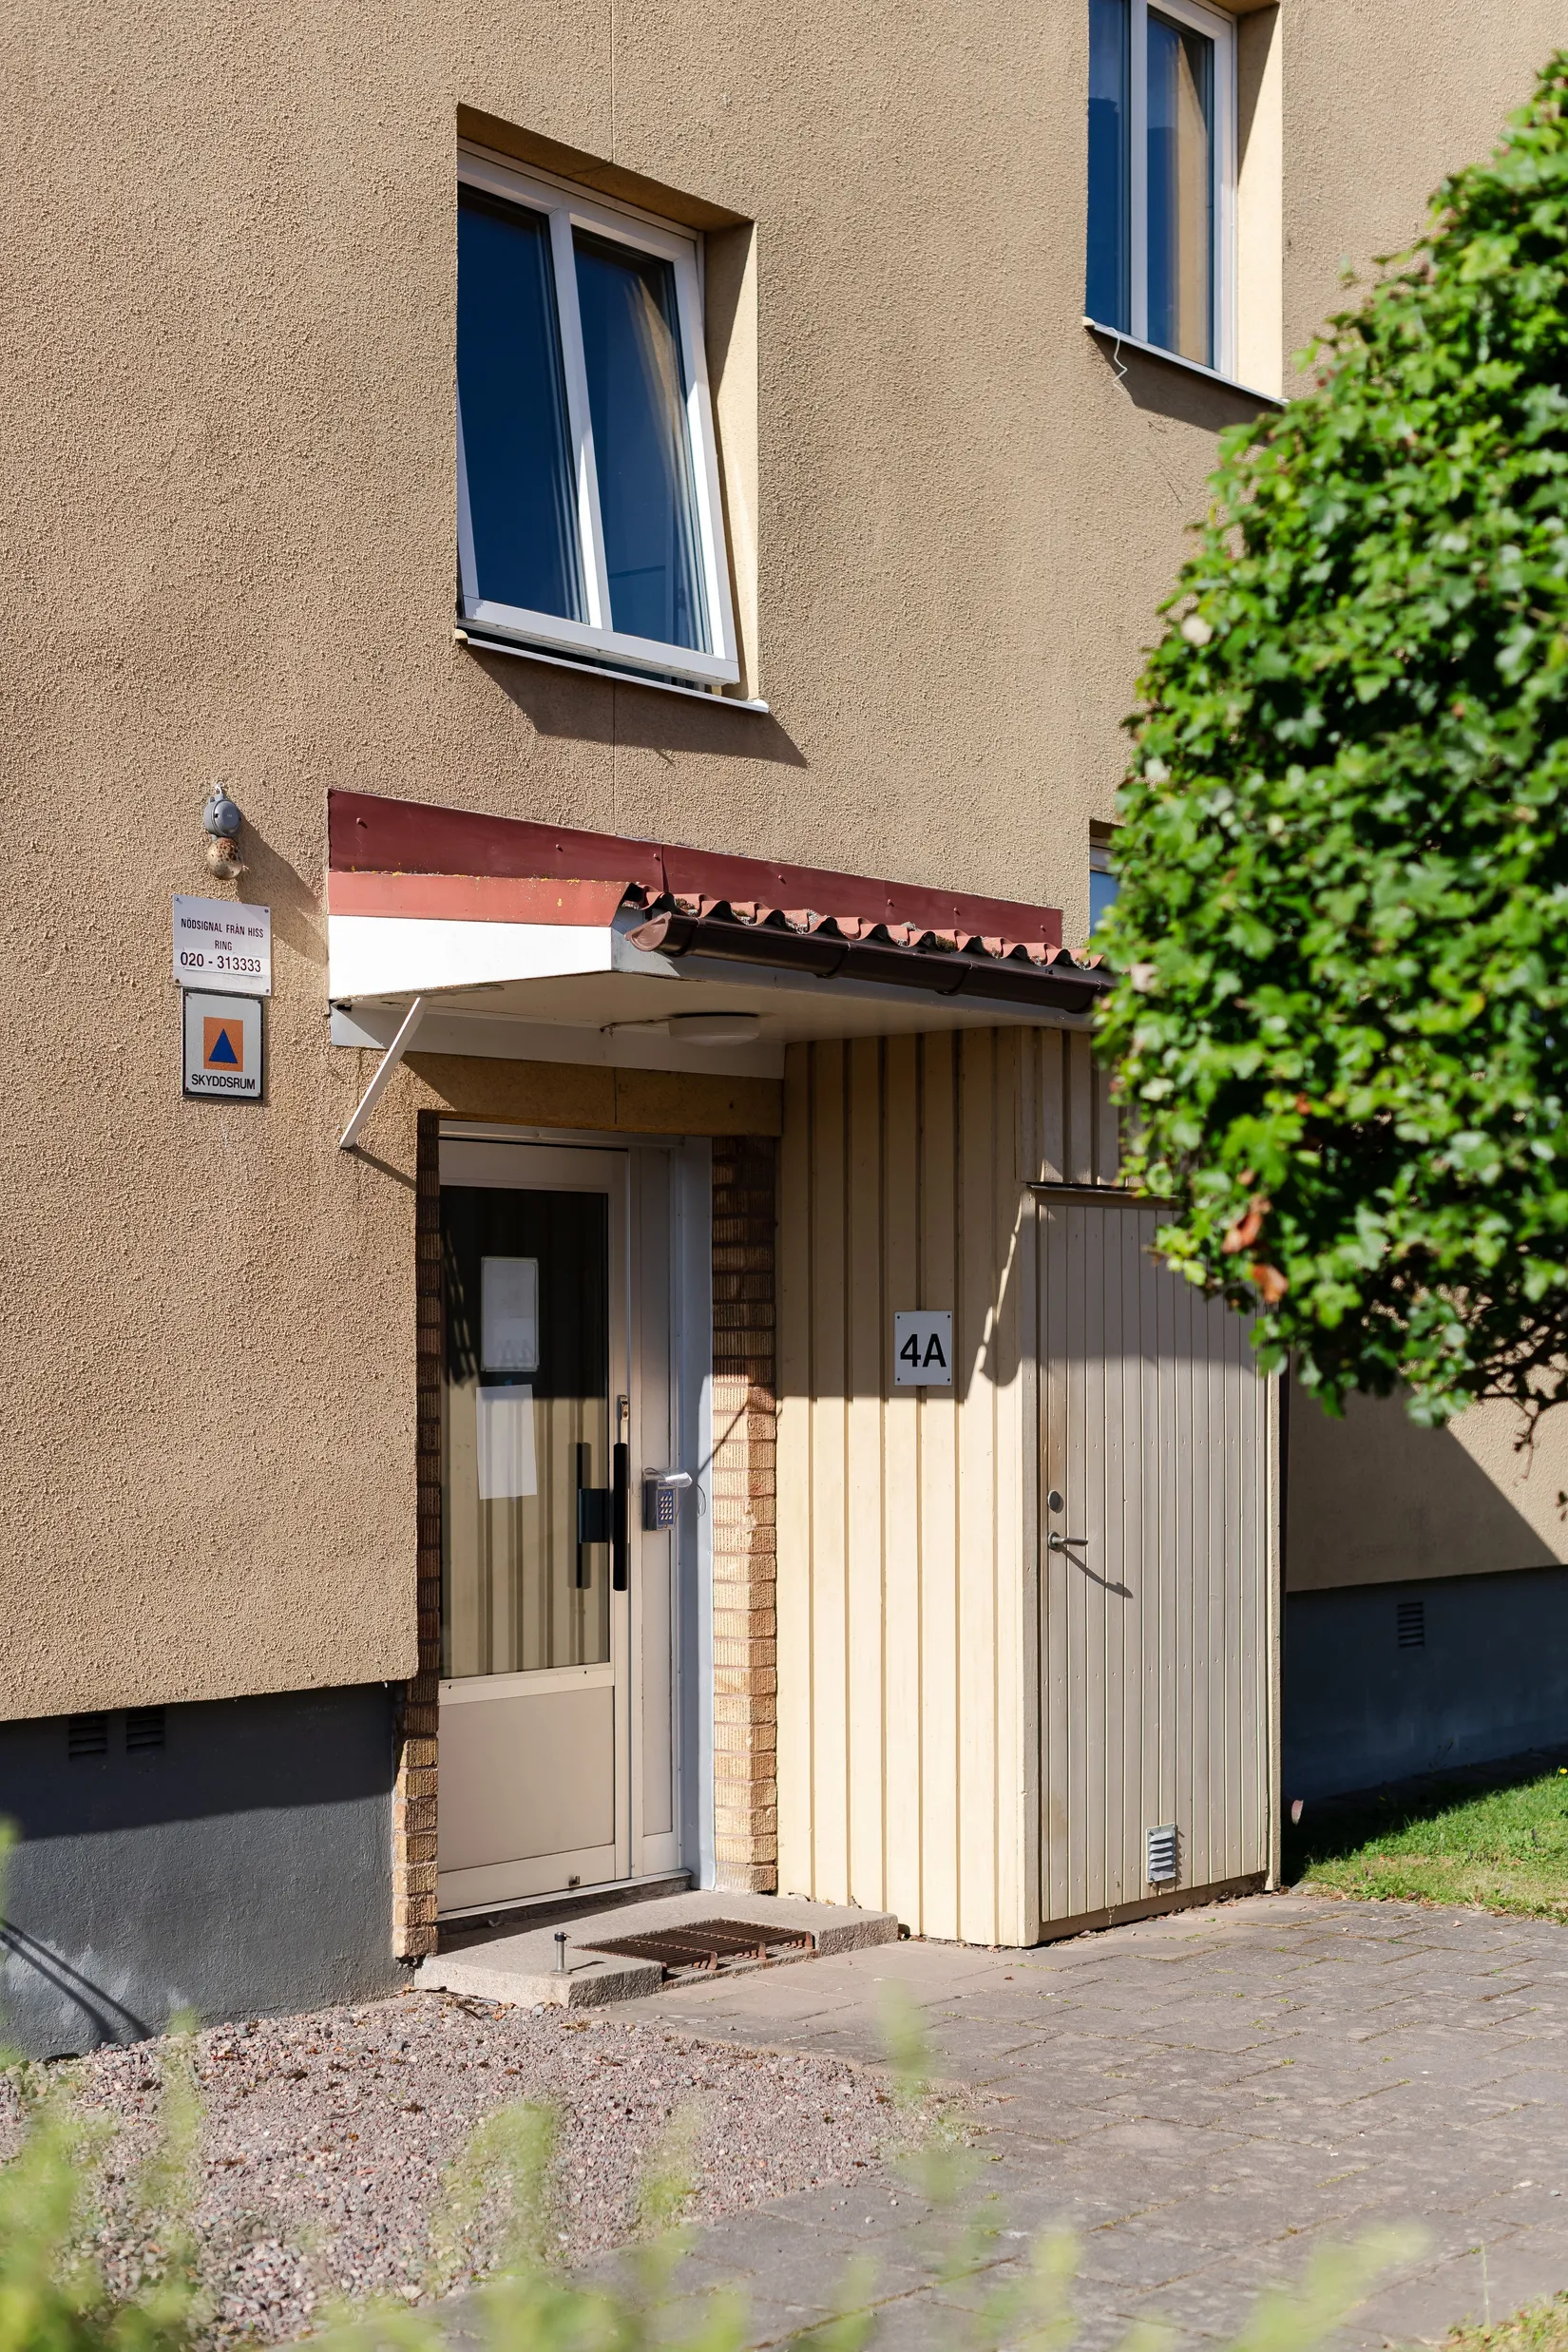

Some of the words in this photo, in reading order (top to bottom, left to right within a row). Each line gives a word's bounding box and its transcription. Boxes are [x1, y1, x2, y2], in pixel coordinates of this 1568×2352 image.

[181, 917, 223, 933] NÖDSIGNAL
[225, 923, 245, 935] FRÅN
[247, 927, 264, 938] HISS
[214, 939, 233, 951] RING
[180, 951, 204, 967] 020
[217, 955, 261, 973] 313333
[191, 1073, 256, 1090] SKYDDSRUM
[899, 1333, 947, 1367] 4A
